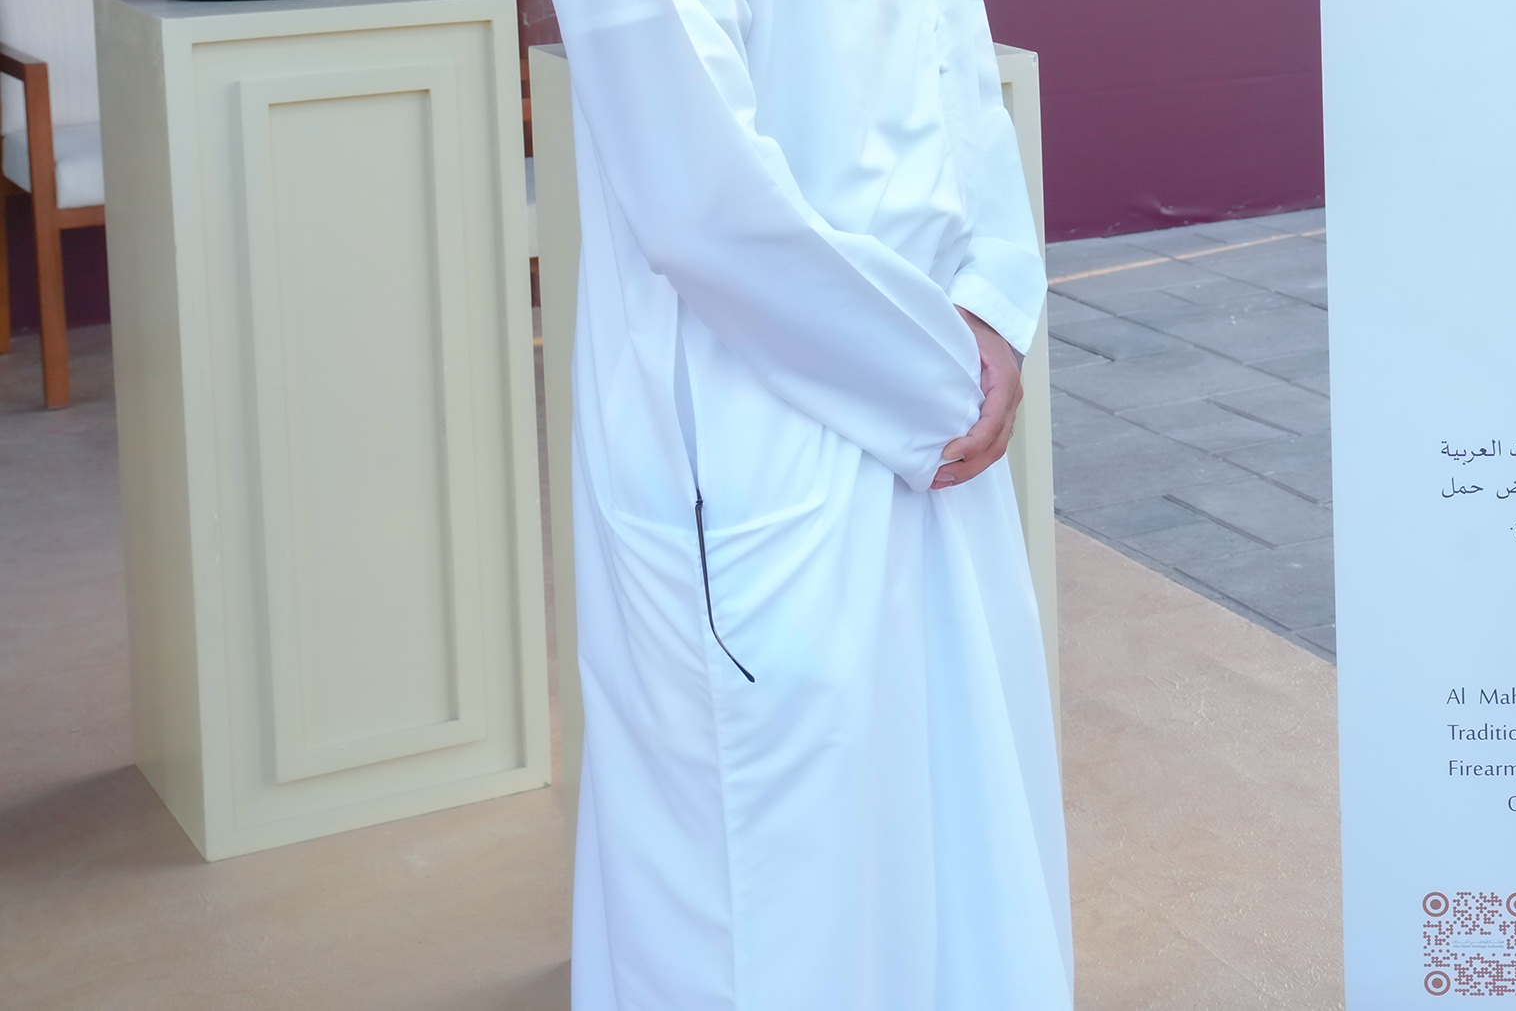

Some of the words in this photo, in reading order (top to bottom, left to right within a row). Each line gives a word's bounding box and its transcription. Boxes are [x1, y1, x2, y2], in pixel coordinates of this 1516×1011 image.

[1440, 439, 1502, 466] العربية
[1441, 476, 1484, 499] حمل
[1446, 686, 1466, 705] Al
